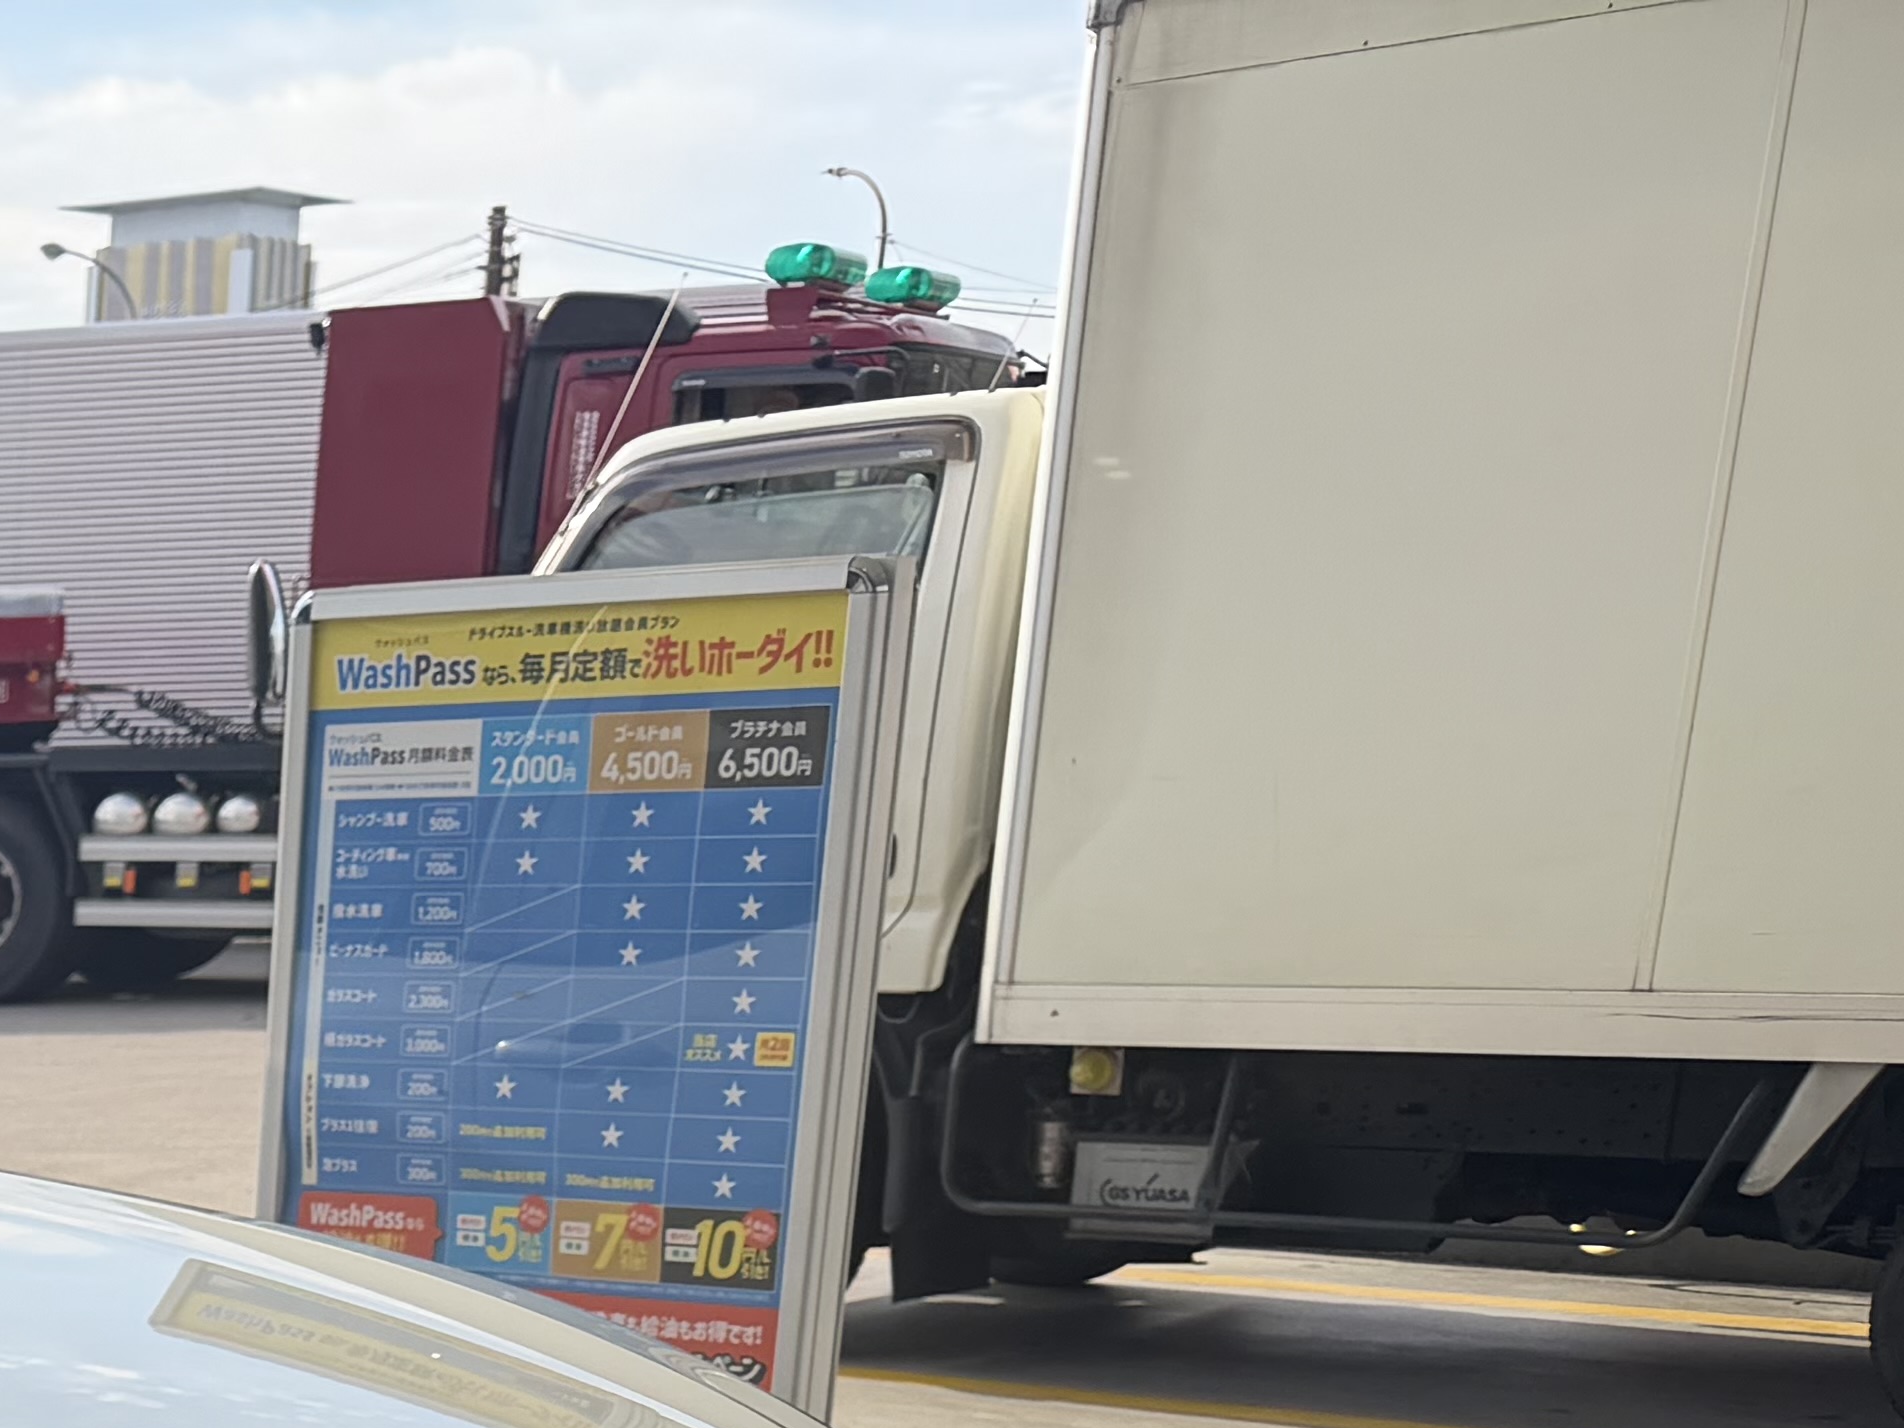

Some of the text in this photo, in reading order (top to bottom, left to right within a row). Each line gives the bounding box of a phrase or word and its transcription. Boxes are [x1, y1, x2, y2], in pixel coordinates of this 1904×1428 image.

[336, 652, 477, 691] WashPass
[729, 719, 807, 739] プラチナ会員
[490, 754, 577, 787] 2,000円
[600, 751, 692, 783] 4,500円
[717, 746, 814, 783] 6,500円
[309, 1201, 405, 1230] WashPass
[485, 1206, 521, 1263] 5
[592, 1213, 629, 1271] 7
[692, 1218, 744, 1280] 10
